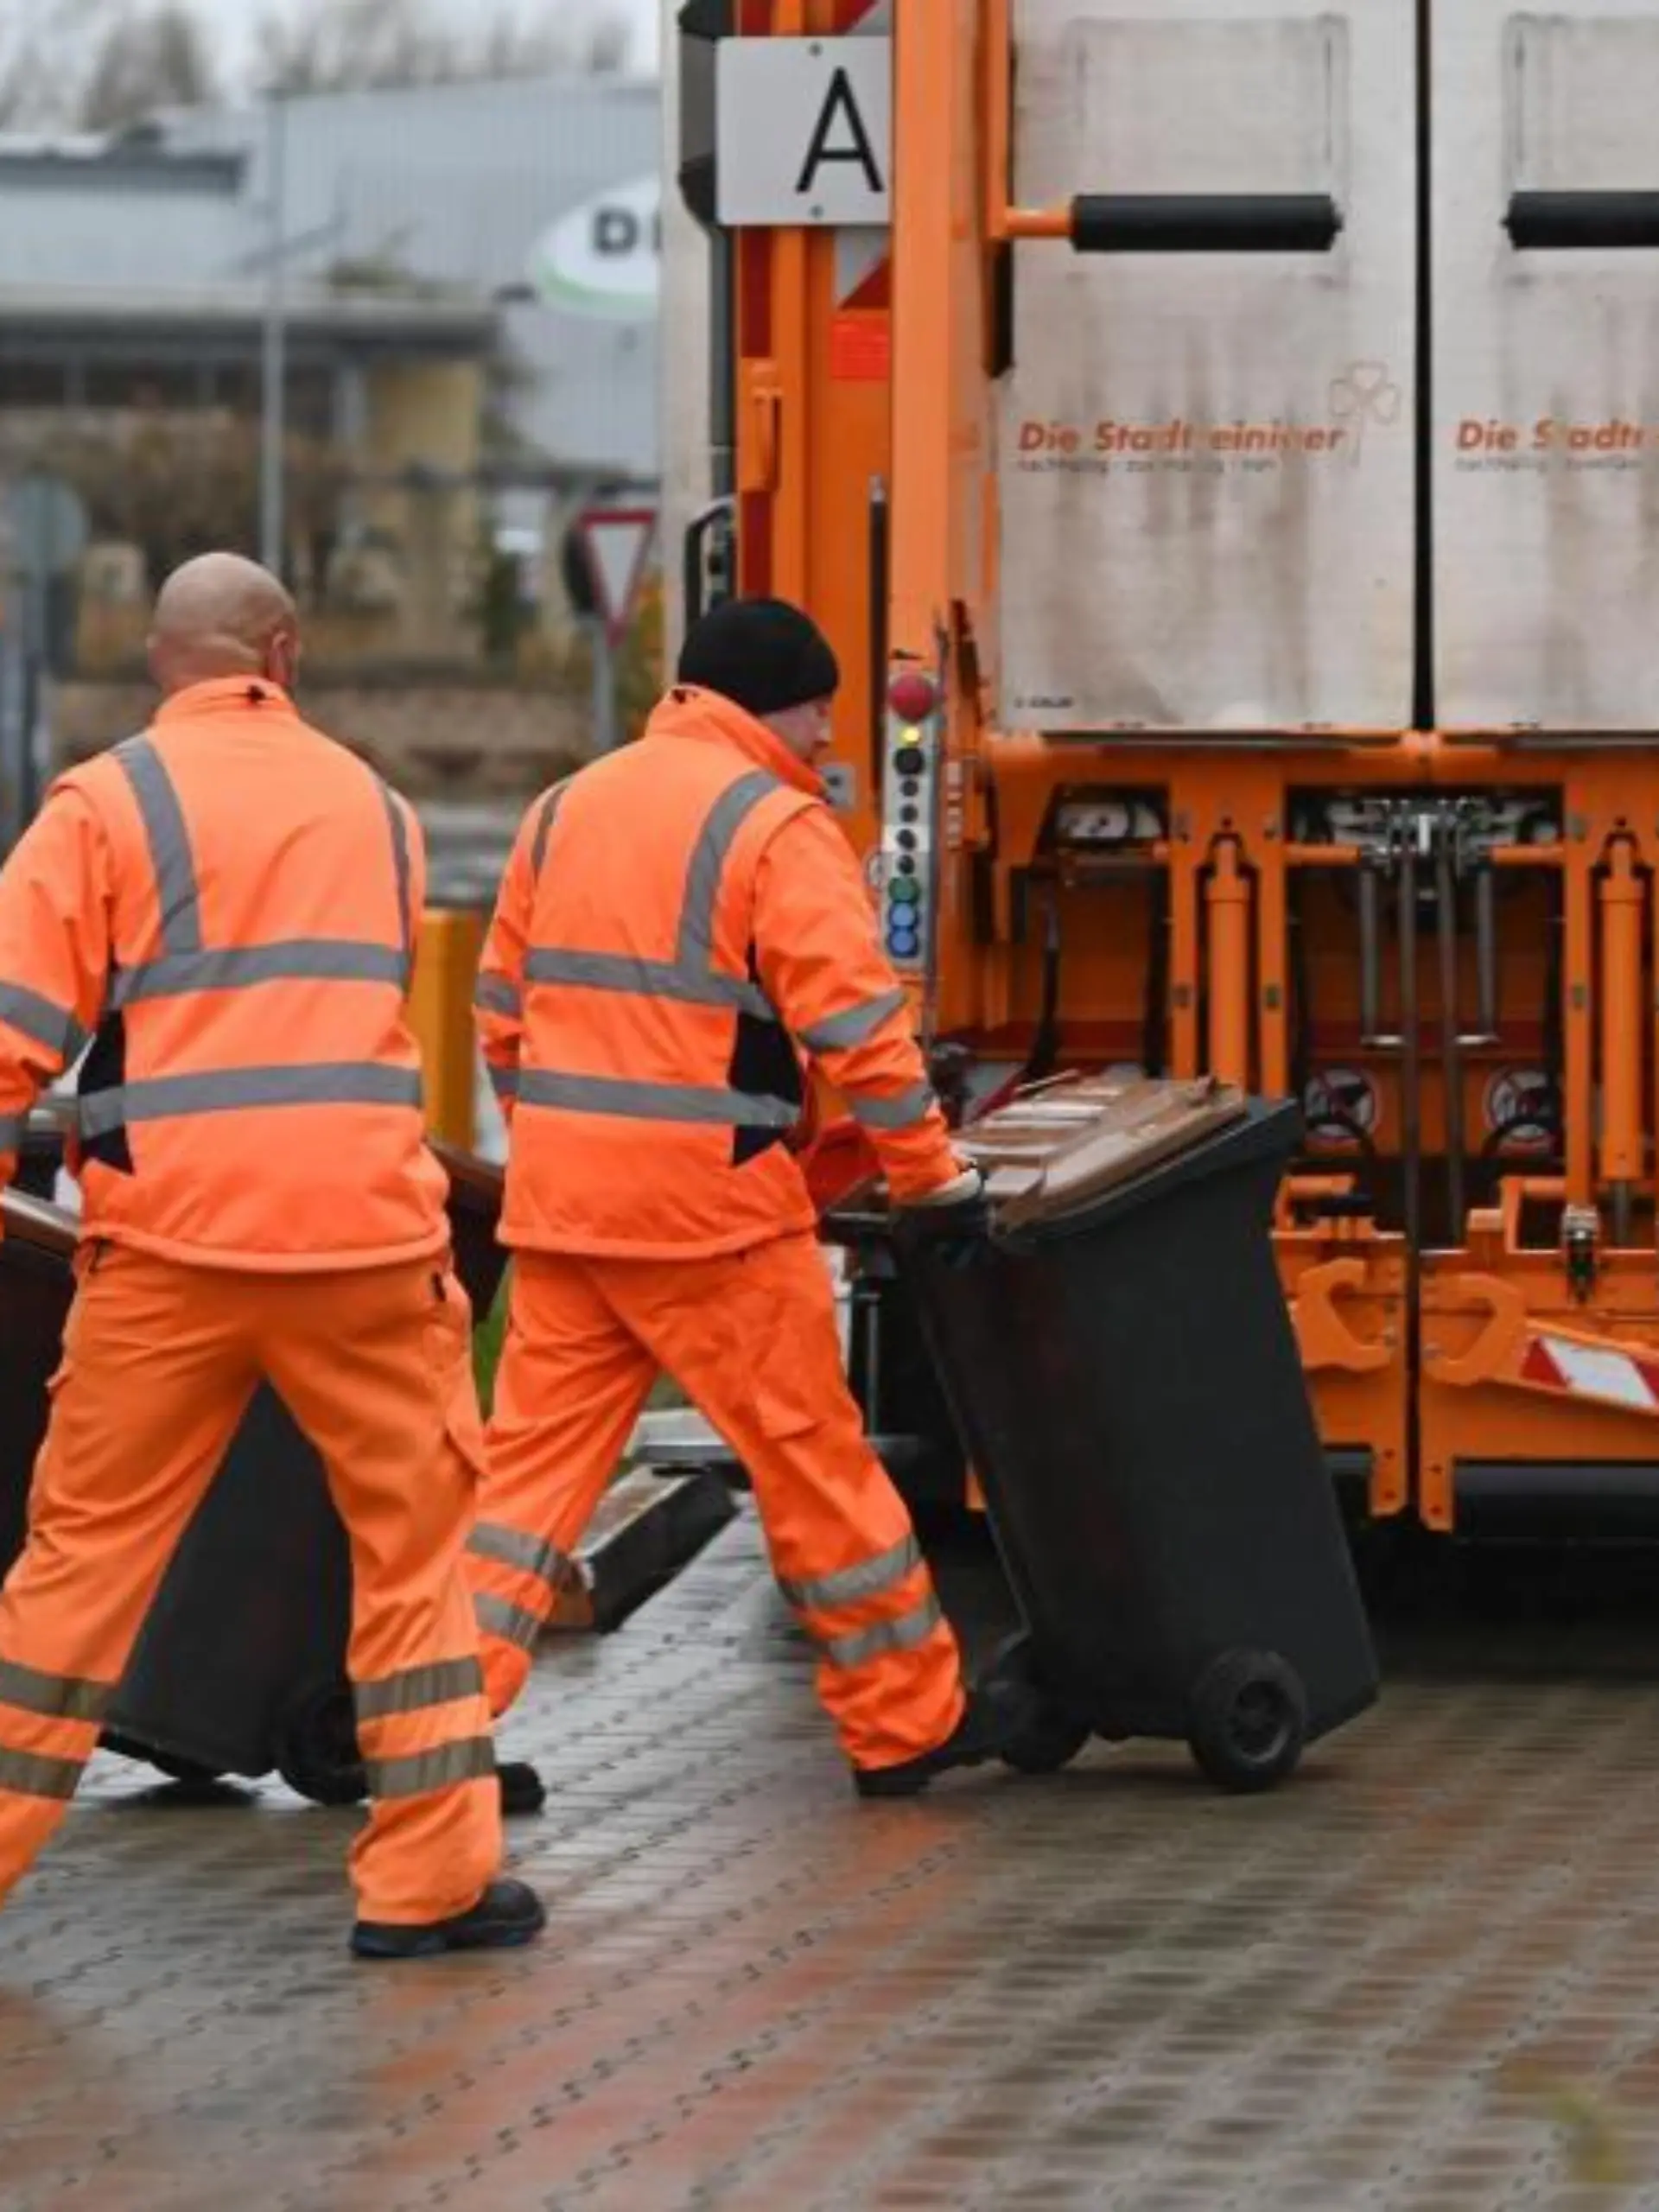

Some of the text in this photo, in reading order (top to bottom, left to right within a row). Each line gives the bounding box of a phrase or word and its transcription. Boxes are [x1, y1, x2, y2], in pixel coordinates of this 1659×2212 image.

[796, 66, 884, 193] A
[594, 207, 661, 256] D
[1018, 420, 1346, 451] Die Stadteinier
[1459, 420, 1658, 451] Die Sadtr
